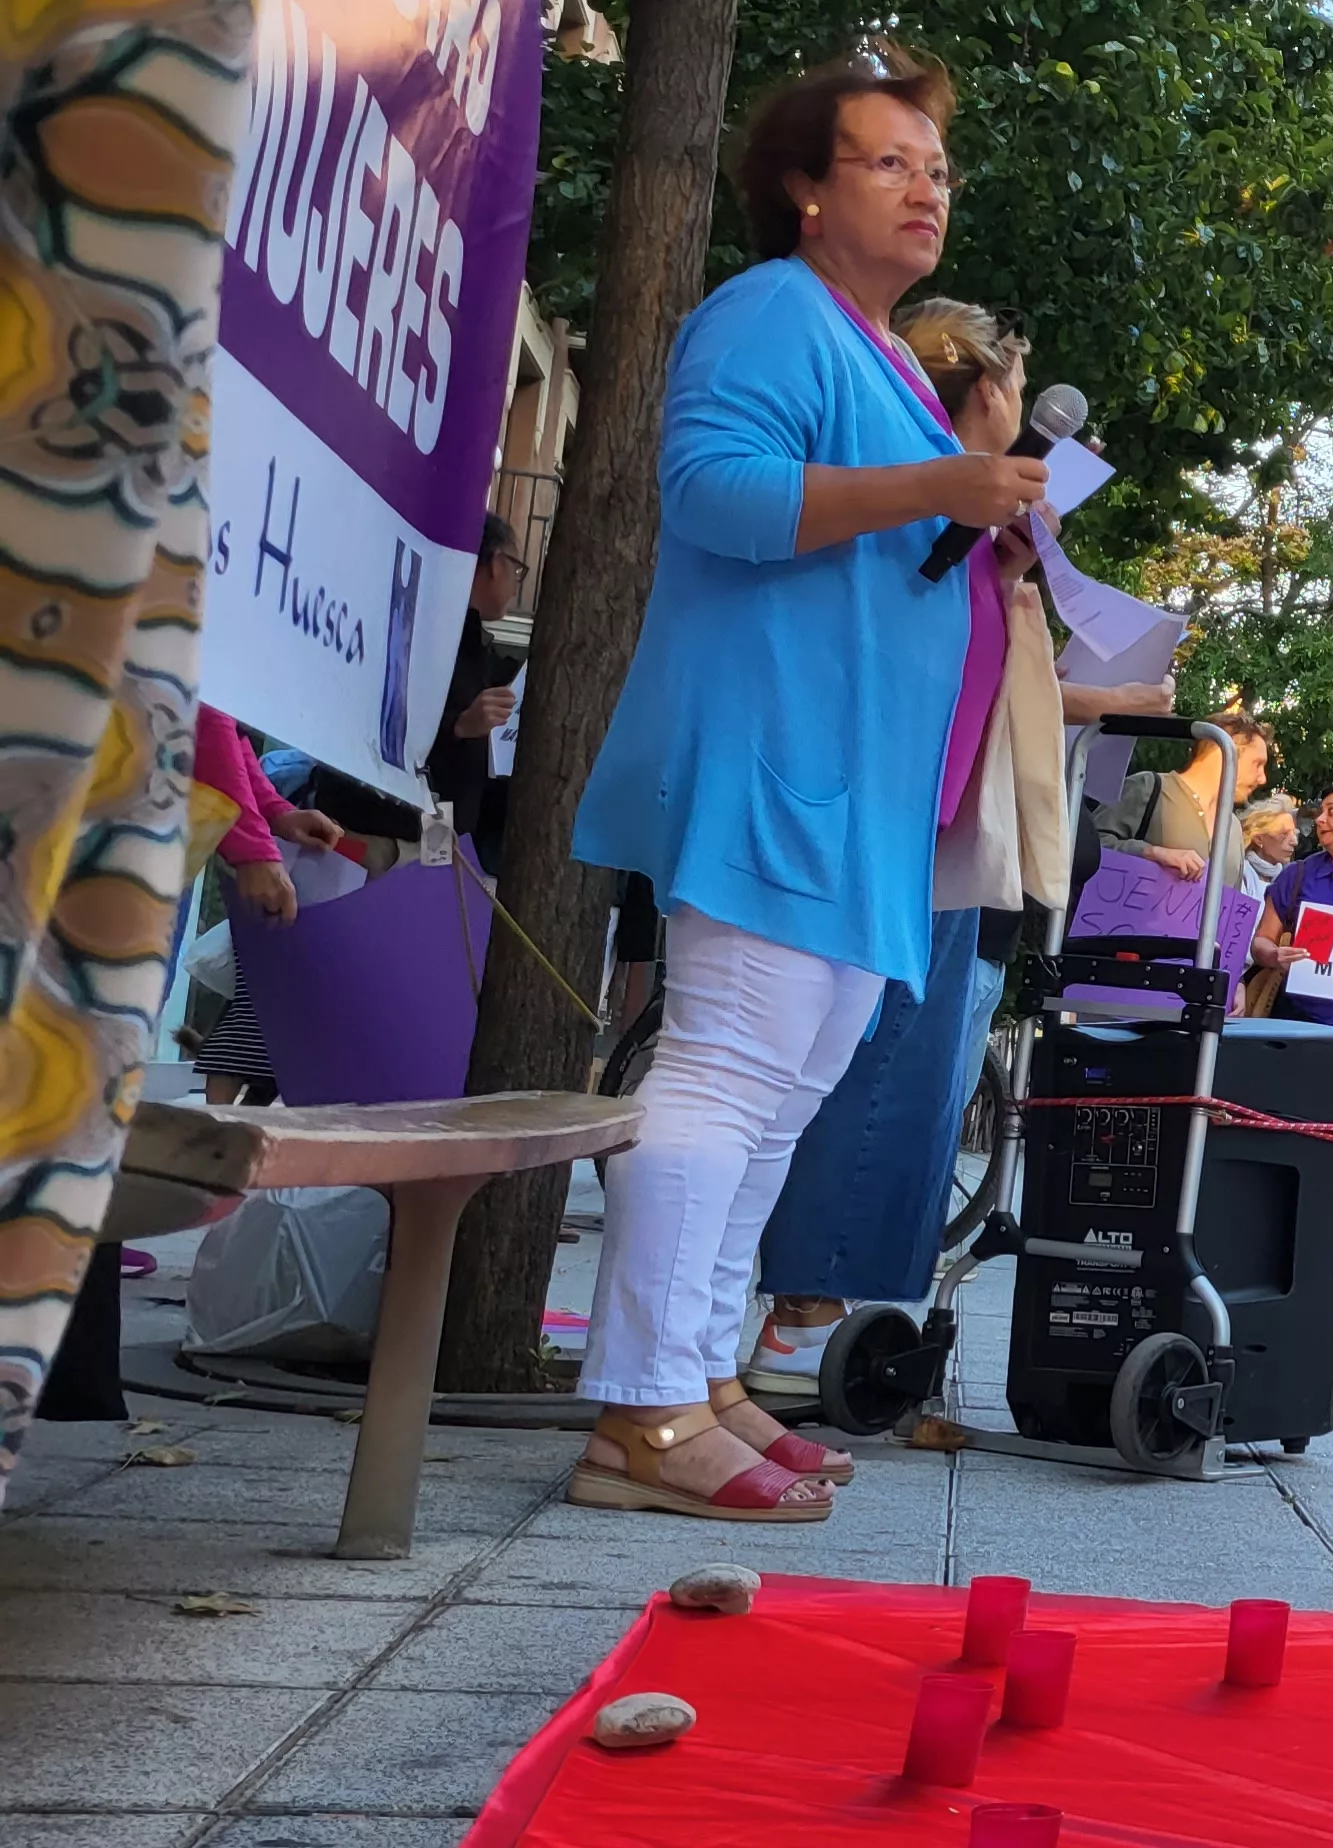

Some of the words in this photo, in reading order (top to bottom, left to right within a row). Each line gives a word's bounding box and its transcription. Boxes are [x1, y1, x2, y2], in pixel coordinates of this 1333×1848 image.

[223, 0, 464, 455] MUJERES
[255, 456, 364, 665] Huesca
[1084, 1228, 1133, 1245] ALTO
